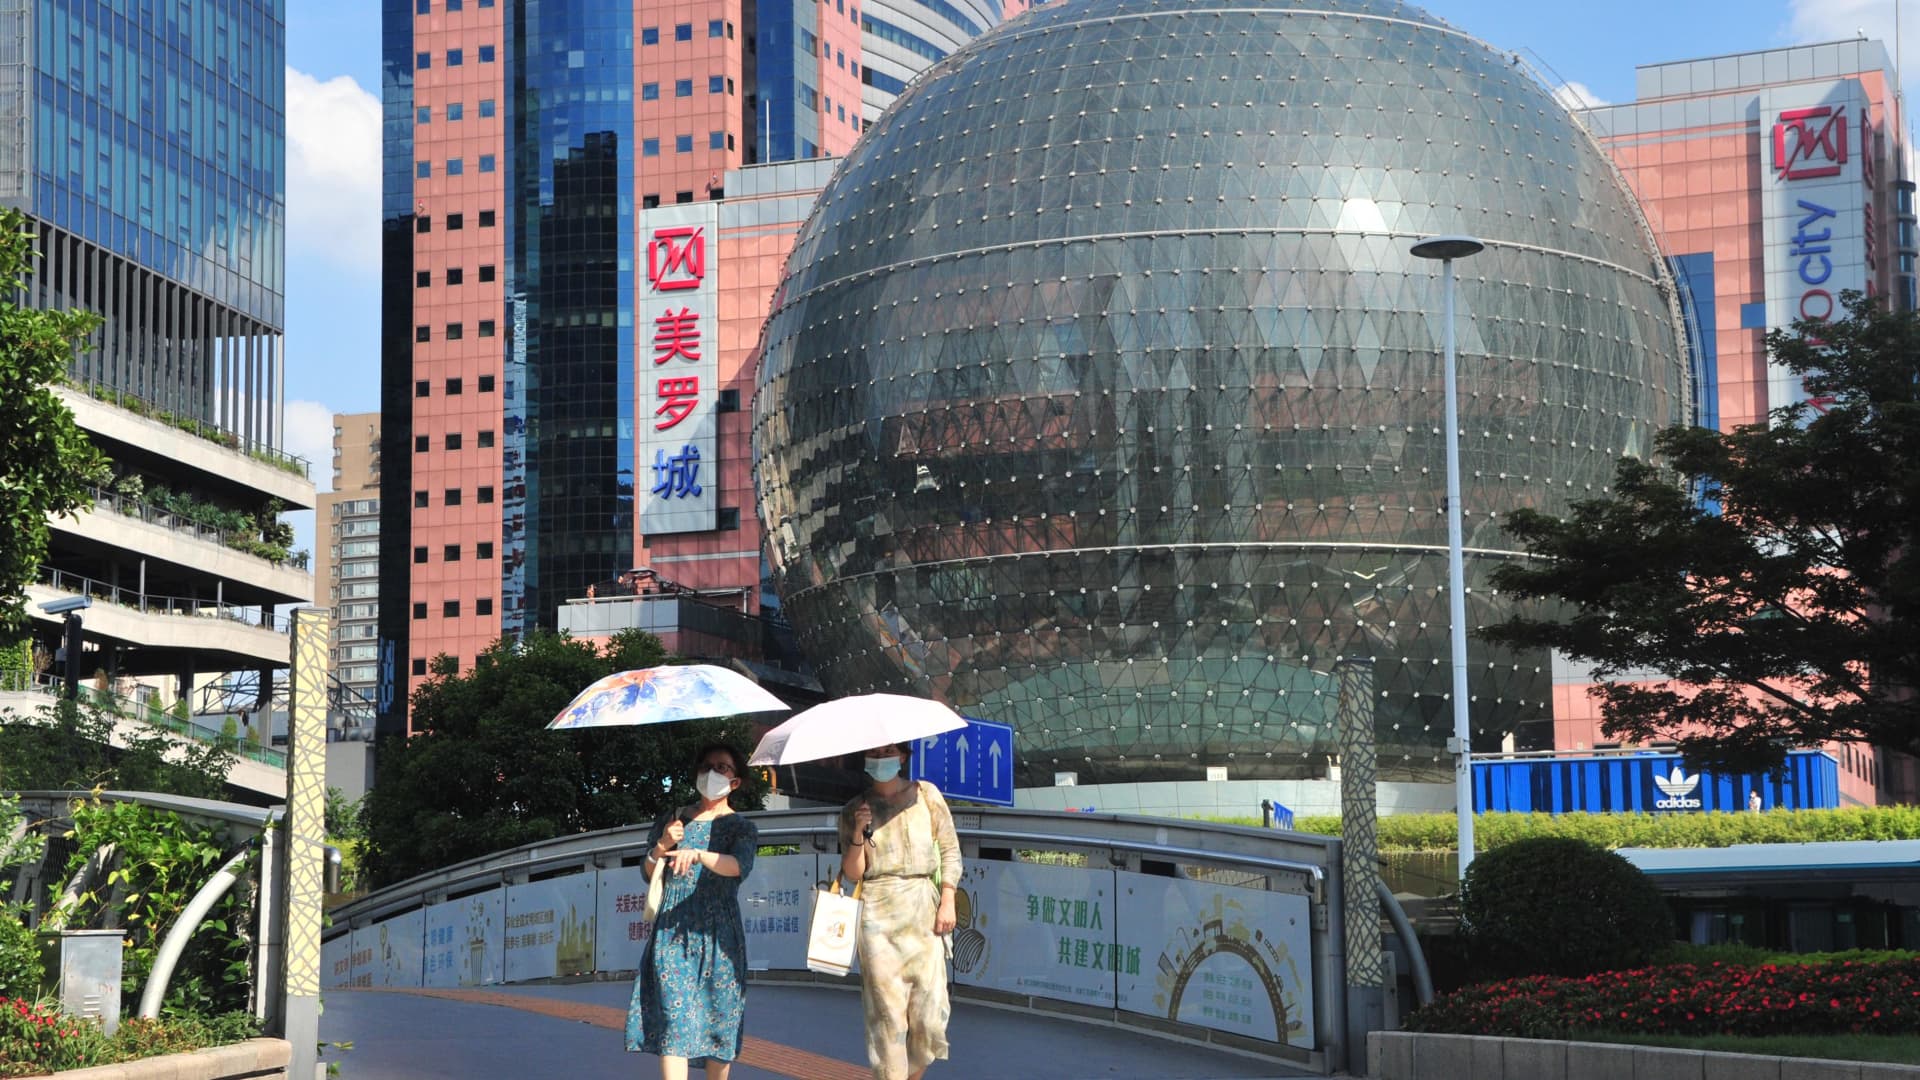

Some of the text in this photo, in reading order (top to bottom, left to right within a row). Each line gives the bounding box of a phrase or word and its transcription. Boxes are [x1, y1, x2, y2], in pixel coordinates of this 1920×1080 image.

[1790, 200, 1837, 285] city
[652, 306, 703, 500] 美罗城
[1656, 797, 1701, 808] adidas
[1027, 894, 1103, 930] 争做文明人
[1058, 936, 1141, 976] 共建文明城
